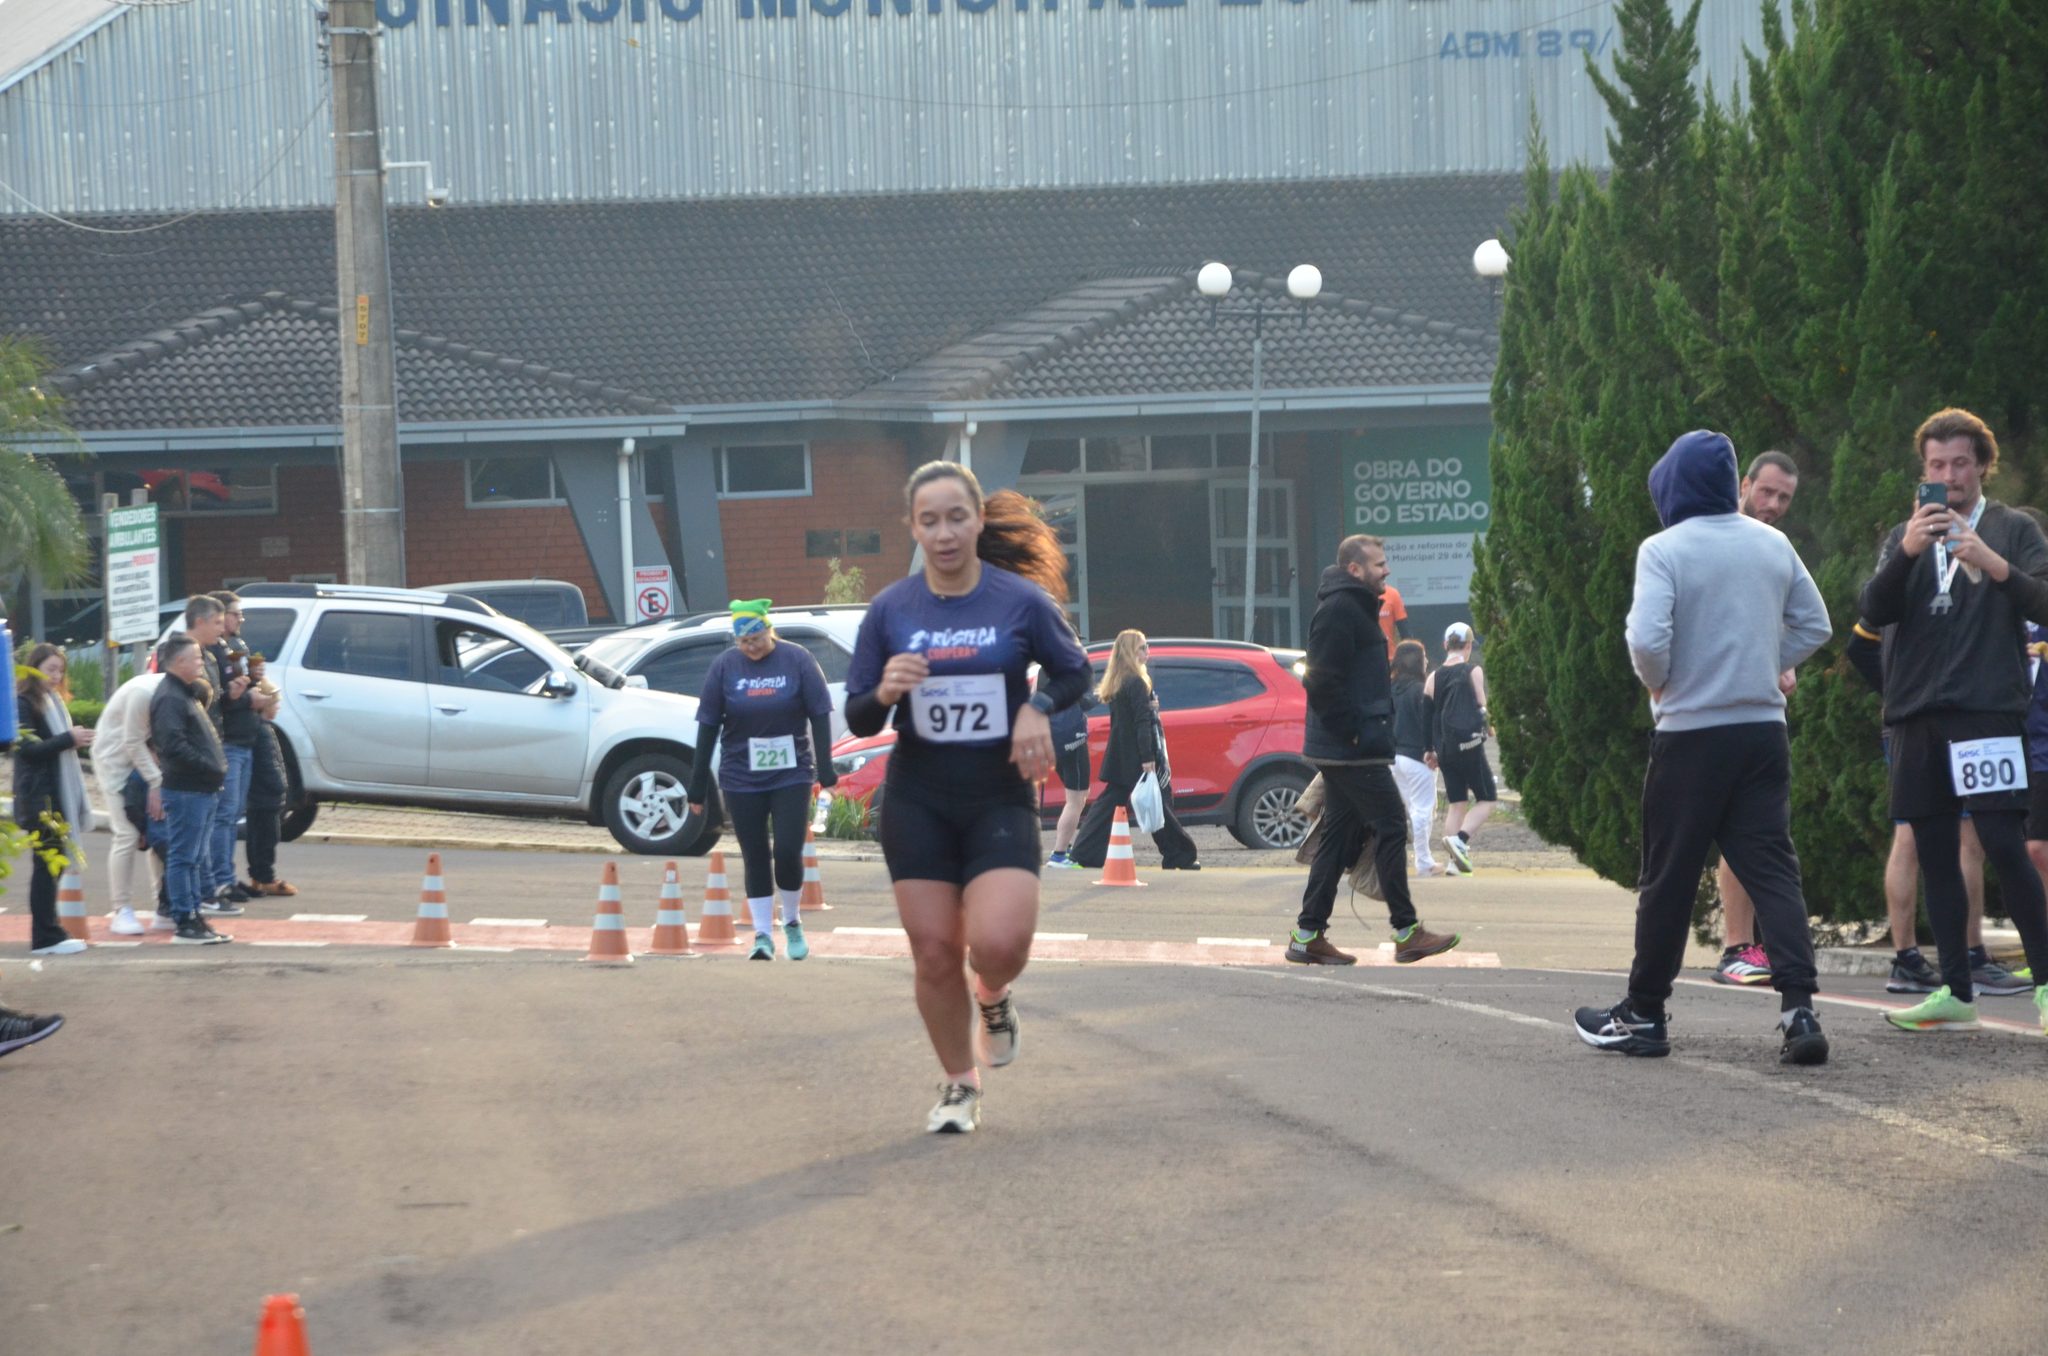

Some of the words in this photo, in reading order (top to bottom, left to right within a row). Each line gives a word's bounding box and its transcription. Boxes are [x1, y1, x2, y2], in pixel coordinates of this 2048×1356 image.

[1440, 31, 1520, 59] ADM
[1354, 461, 1420, 480] OBRA
[1427, 458, 1462, 477] DO
[1354, 480, 1471, 502] GOVERNO
[1356, 506, 1390, 525] DO
[1397, 501, 1489, 522] ESTADO
[1417, 541, 1454, 550] reforma
[1392, 552, 1435, 562] Municipal
[648, 593, 659, 613] E
[929, 703, 989, 733] 972
[756, 748, 788, 767] 221
[1962, 758, 2016, 790] 890
